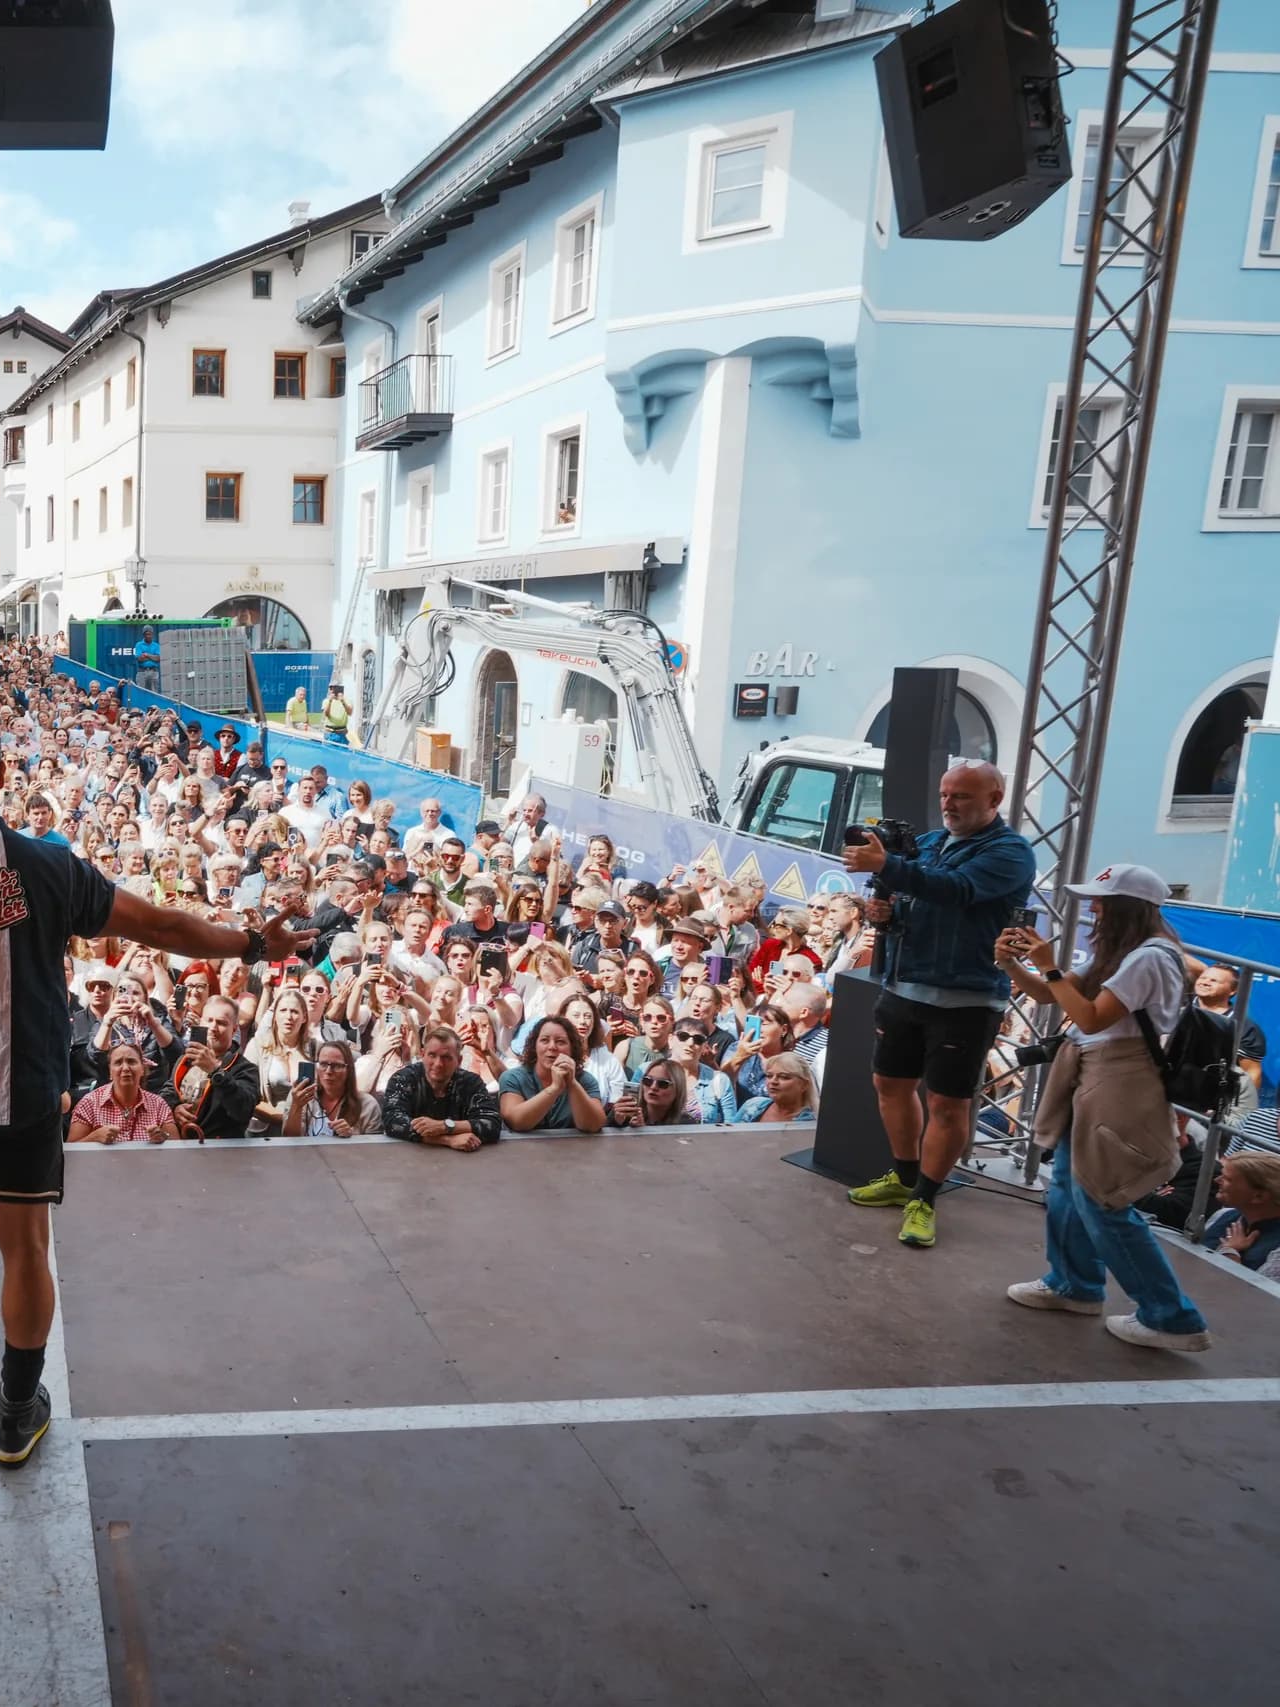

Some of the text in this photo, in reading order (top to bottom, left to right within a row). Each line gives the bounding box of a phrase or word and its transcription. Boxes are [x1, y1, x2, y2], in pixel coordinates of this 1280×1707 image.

[471, 560, 538, 580] restaurant
[744, 642, 818, 677] BAR
[584, 734, 600, 747] 59
[562, 828, 646, 864] HEOG
